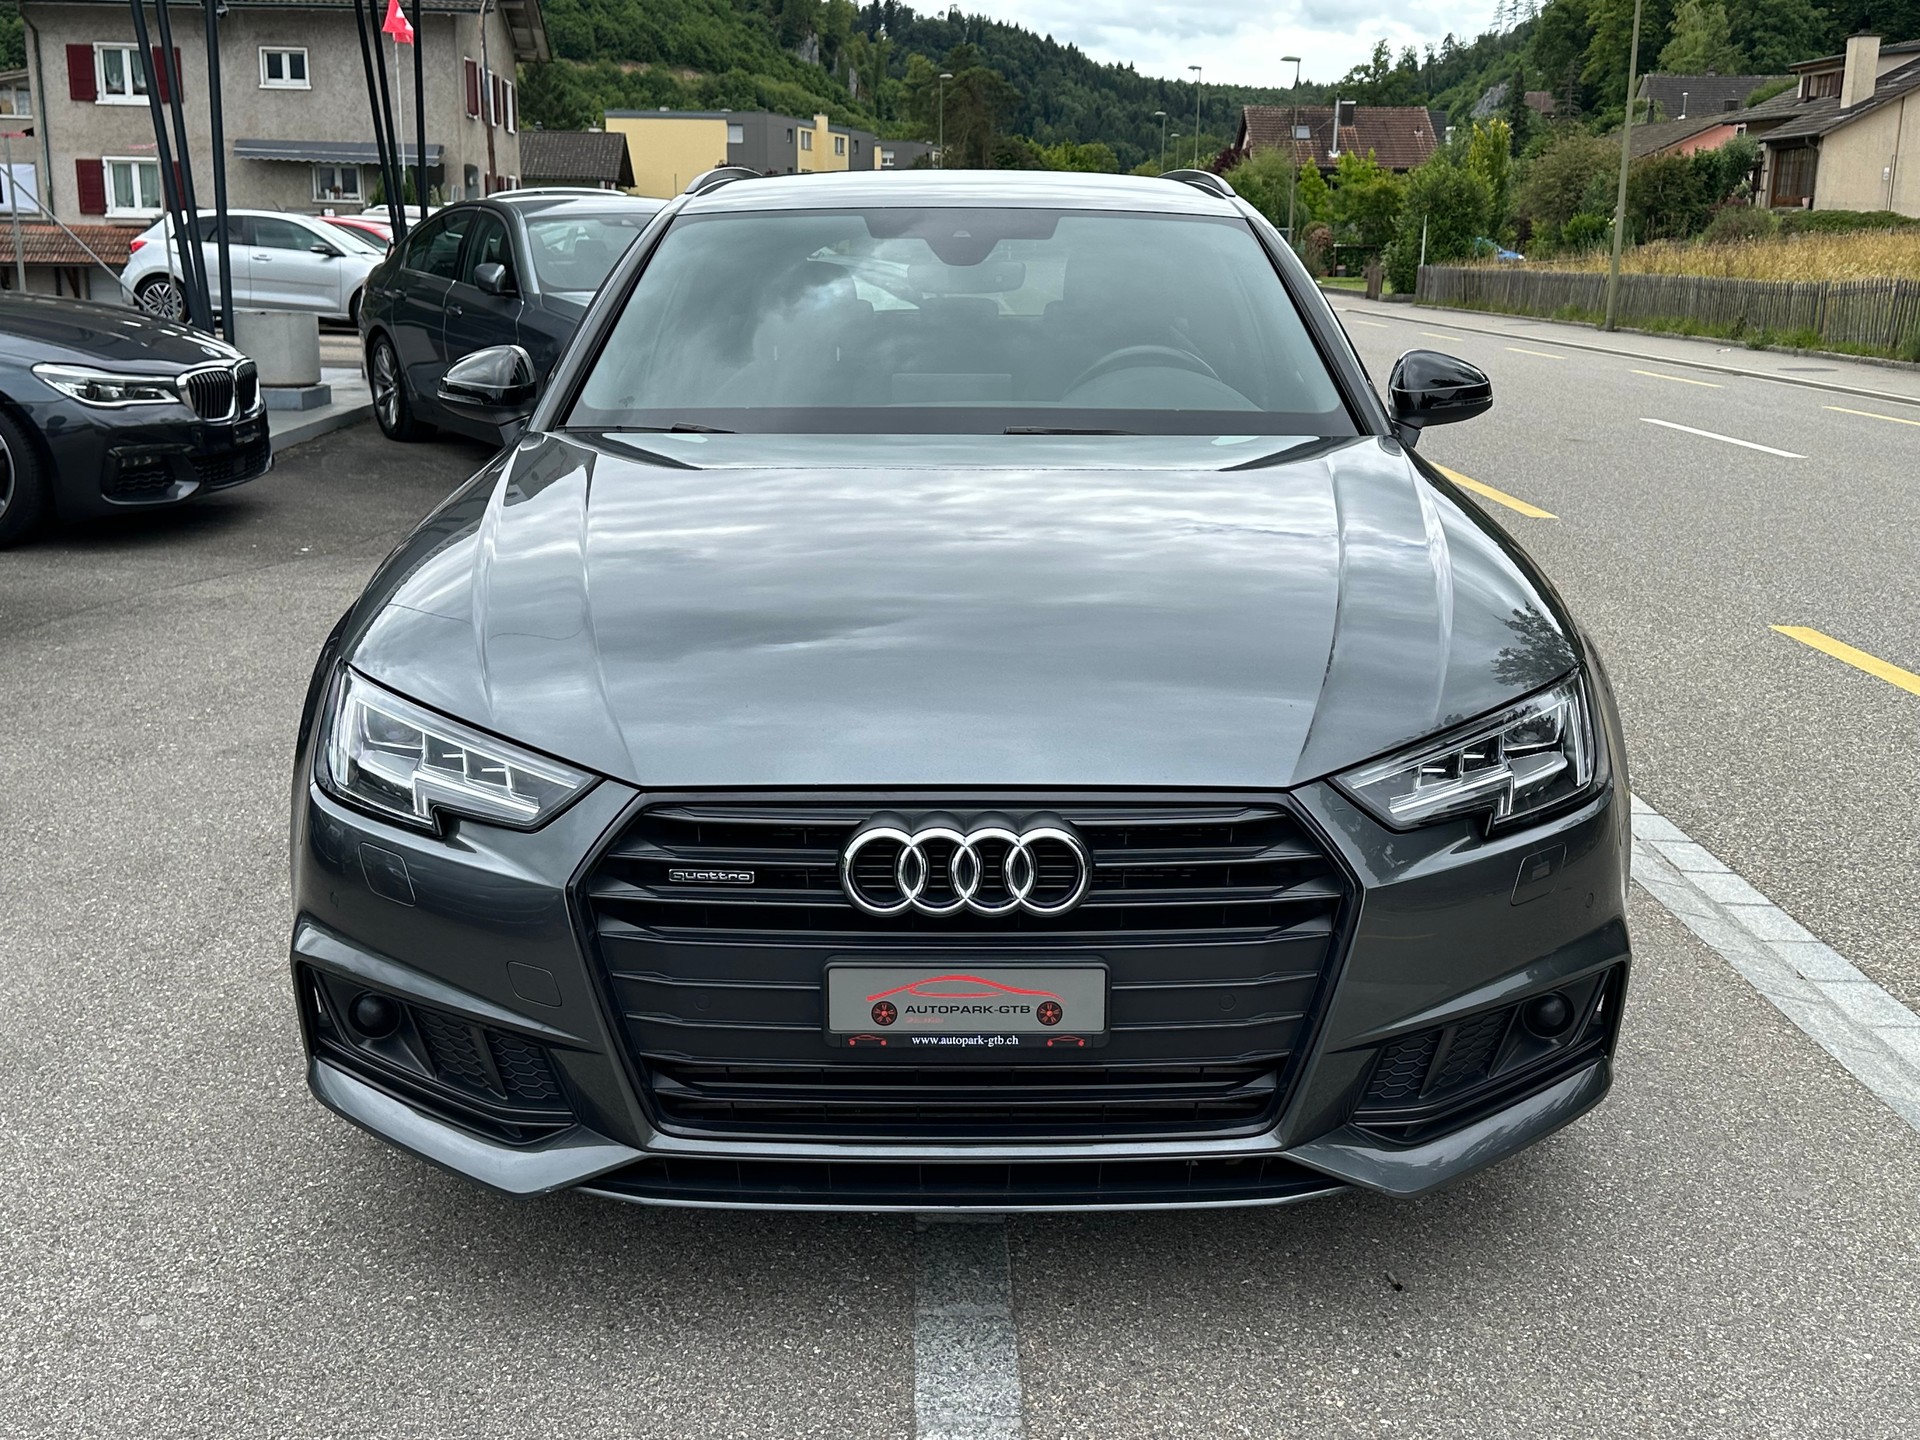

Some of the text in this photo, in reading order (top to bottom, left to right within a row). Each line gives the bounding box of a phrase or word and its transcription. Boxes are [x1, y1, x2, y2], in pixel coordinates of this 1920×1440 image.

[672, 871, 751, 882] quattro
[904, 1005, 1031, 1014] AUTOPARK-GTB
[911, 1034, 1019, 1048] www.autopark-gtb.ch
